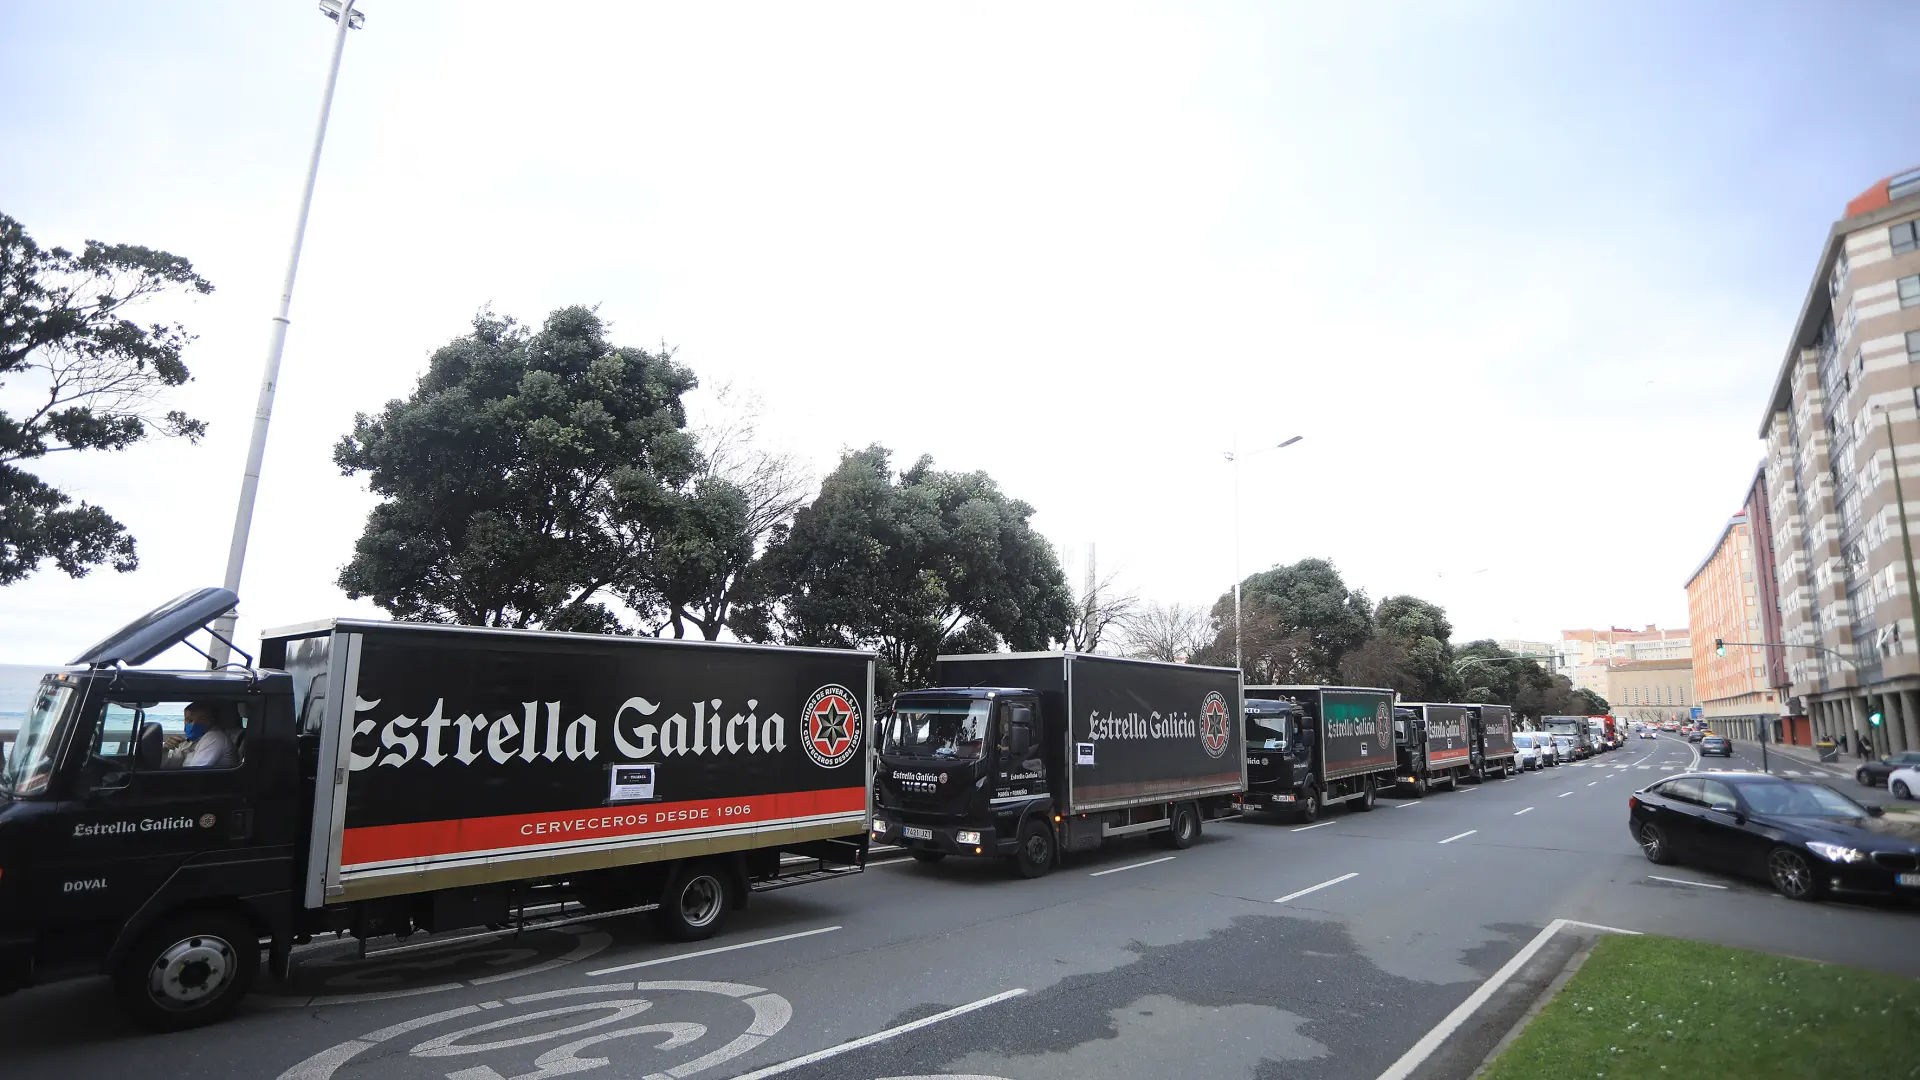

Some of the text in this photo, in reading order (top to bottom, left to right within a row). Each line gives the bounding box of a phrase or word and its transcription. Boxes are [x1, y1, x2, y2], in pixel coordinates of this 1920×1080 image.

[804, 698, 817, 721] HIJOS
[815, 691, 825, 700] DE
[349, 696, 787, 771] Estrella Galicia
[1088, 709, 1196, 741] Estrella Galicia
[1328, 717, 1375, 738] Estrella Galicia
[803, 730, 833, 765] CERVECEROS
[834, 748, 853, 765] DESDE
[1247, 757, 1260, 765] licia
[892, 770, 938, 782] Estrella Galicia
[902, 781, 937, 793] IVECO
[73, 816, 194, 837] Estrella Galicia
[520, 805, 751, 835] CERVECEROS DESDE 1906
[63, 878, 108, 892] DOVAL
